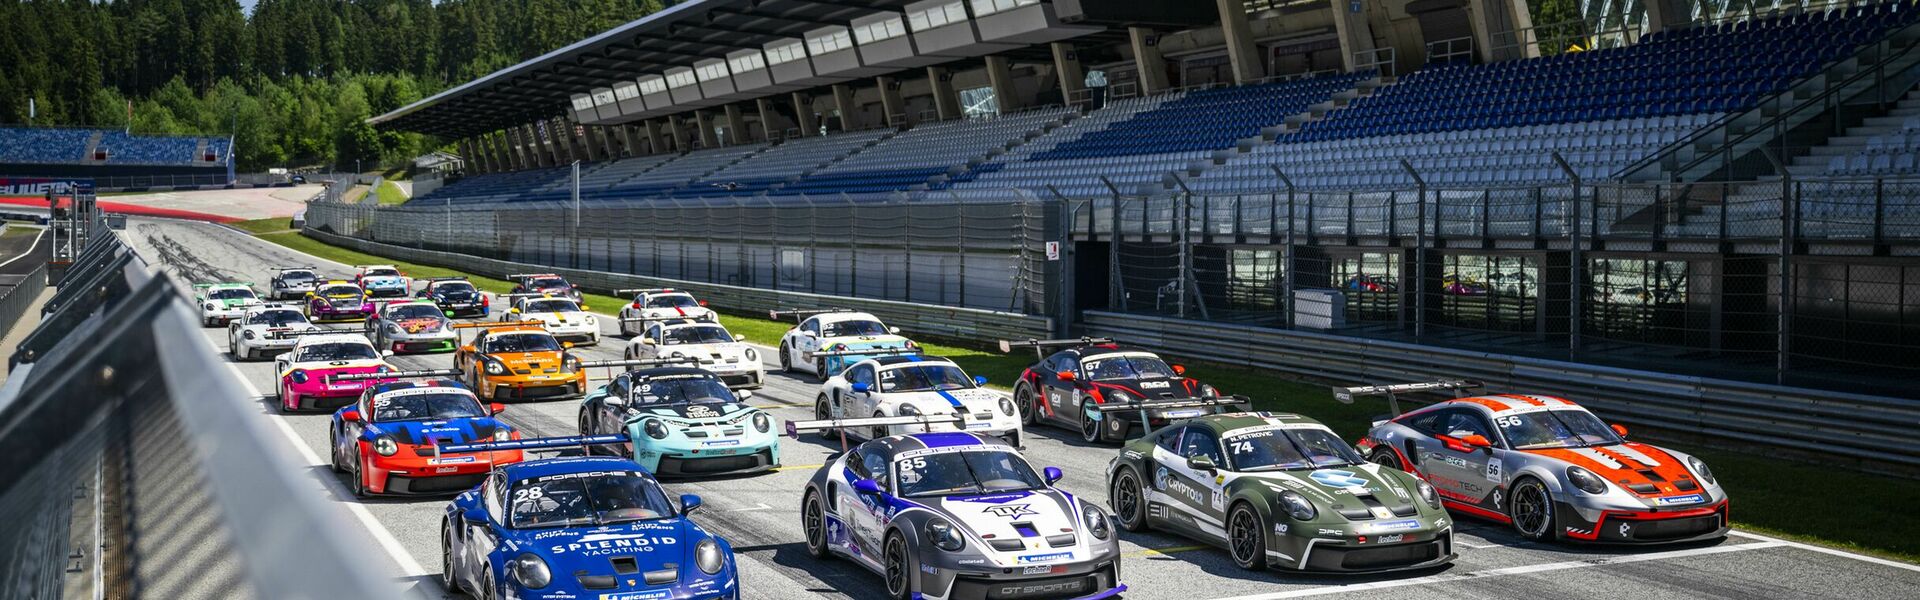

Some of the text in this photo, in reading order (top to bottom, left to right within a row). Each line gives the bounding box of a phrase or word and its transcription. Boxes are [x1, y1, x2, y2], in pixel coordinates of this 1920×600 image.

[1085, 361, 1100, 371] 67
[881, 370, 896, 380] 11
[633, 384, 651, 393] 49
[1497, 415, 1523, 428] 56
[1230, 441, 1255, 455] 74
[900, 457, 927, 471] 85
[1488, 464, 1499, 475] 56
[539, 471, 627, 482] PORSCHE
[515, 486, 543, 501] 28
[1213, 490, 1222, 505] 74
[551, 537, 677, 554] SPLENDID
[582, 546, 654, 557] YACHTING
[1030, 553, 1070, 562] MICHELIN
[1001, 581, 1080, 594] GT SPORTS
[620, 592, 666, 600] MICHELIN
